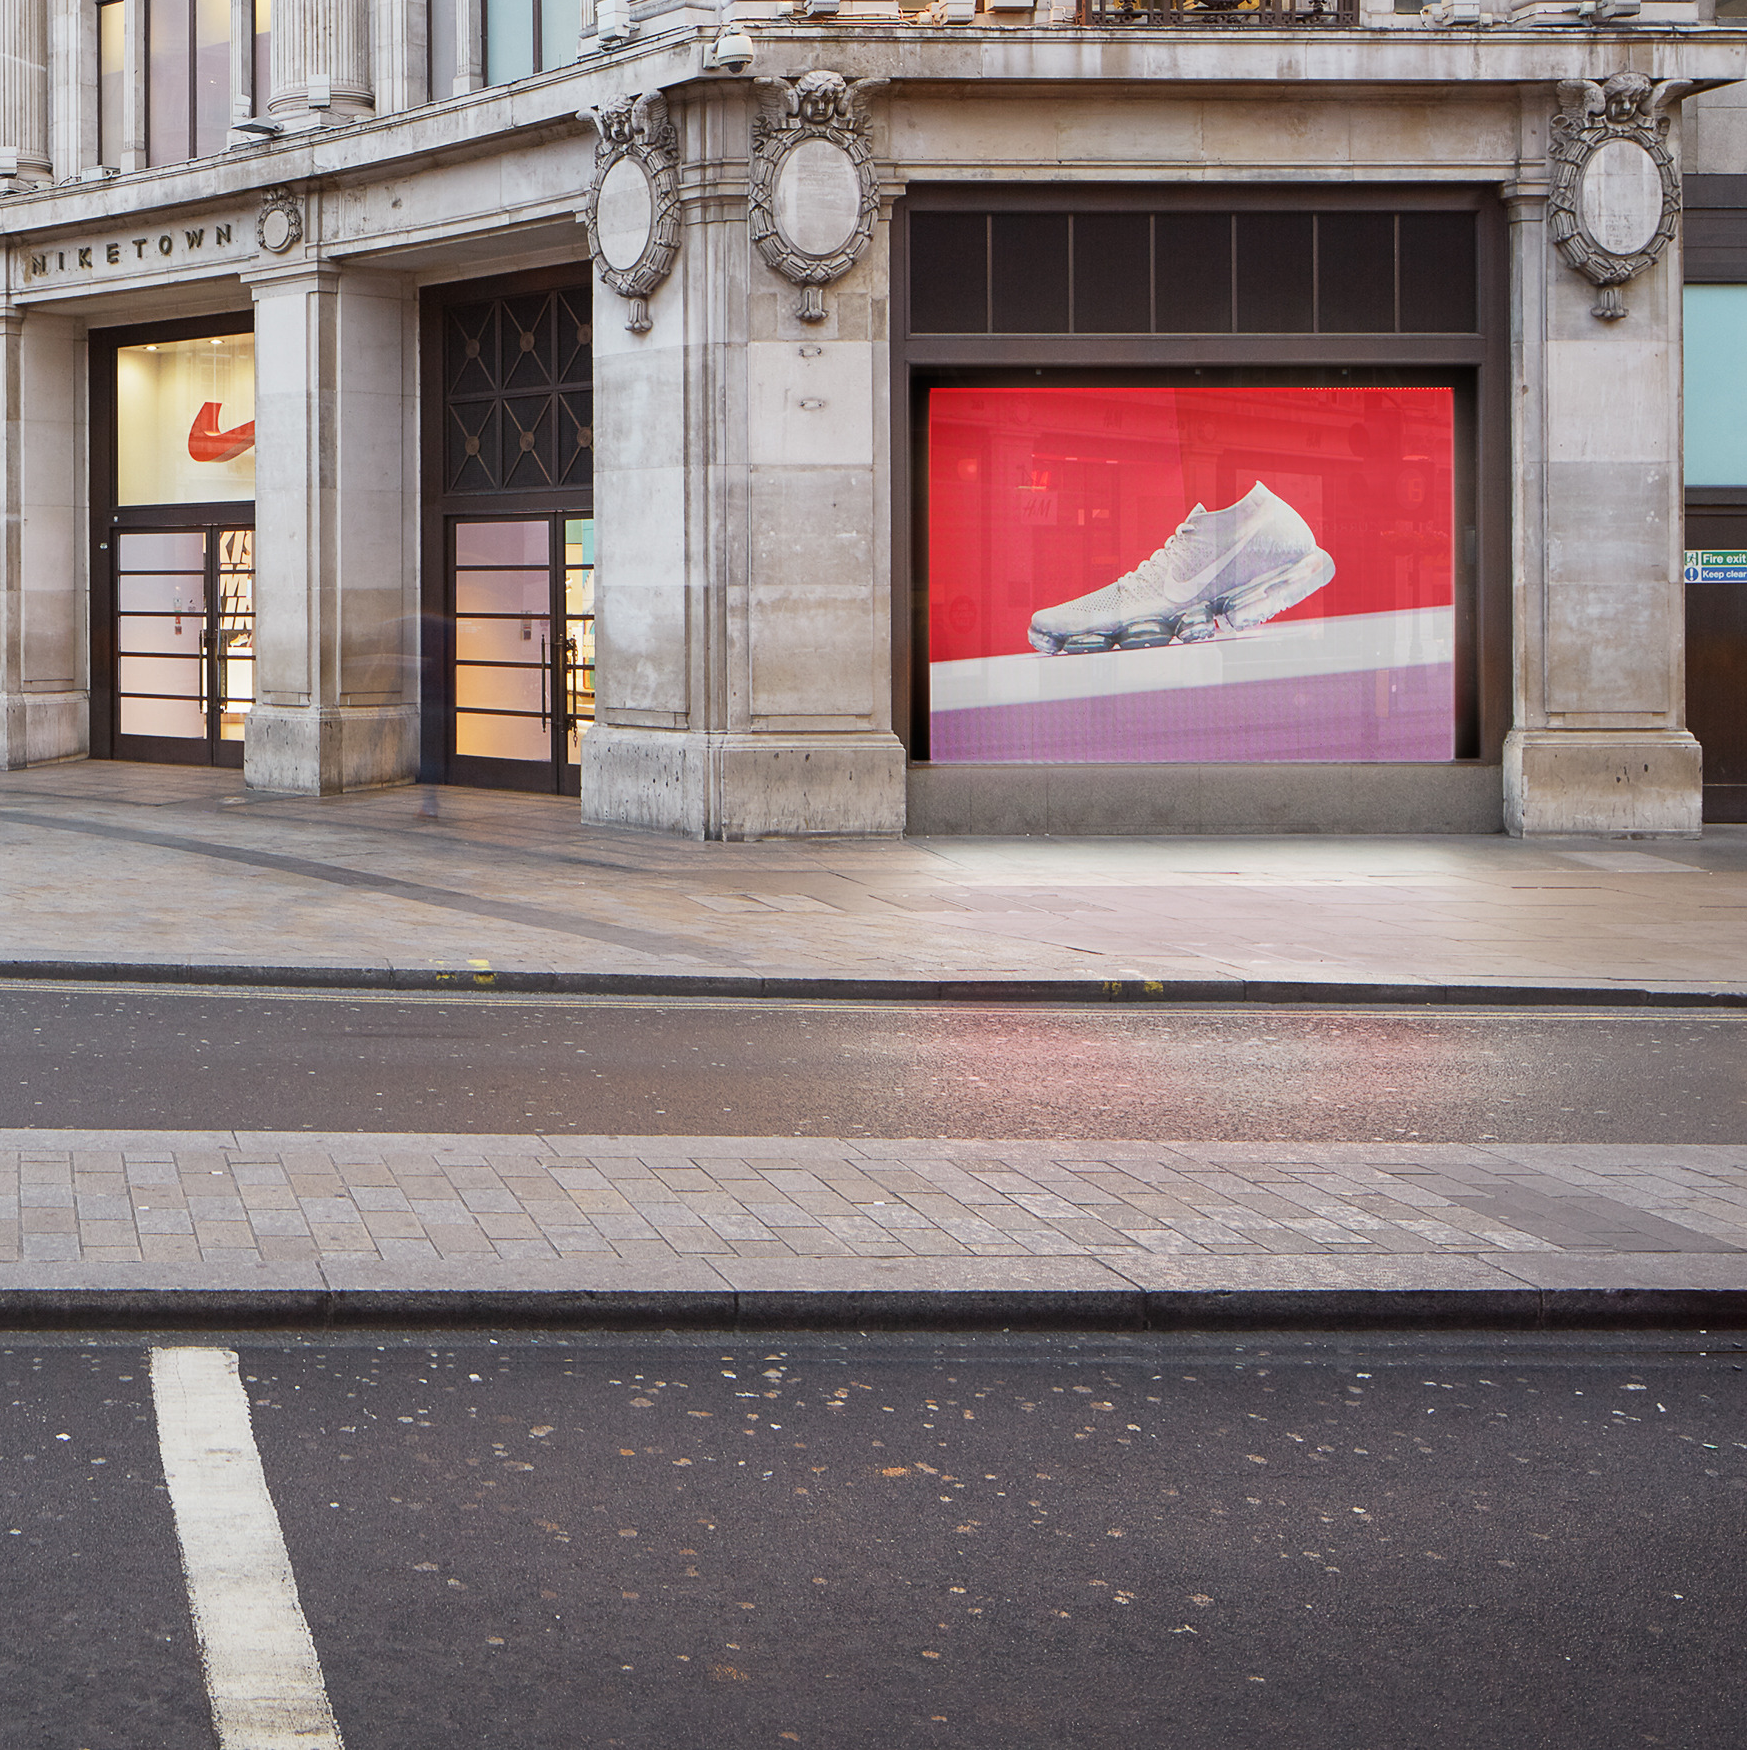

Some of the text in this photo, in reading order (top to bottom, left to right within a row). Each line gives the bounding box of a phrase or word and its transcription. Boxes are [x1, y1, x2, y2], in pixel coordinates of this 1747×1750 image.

[31, 223, 232, 276] NIKETOWN
[1703, 553, 1747, 564] Fire exit
[1703, 570, 1747, 579] Keep clear
